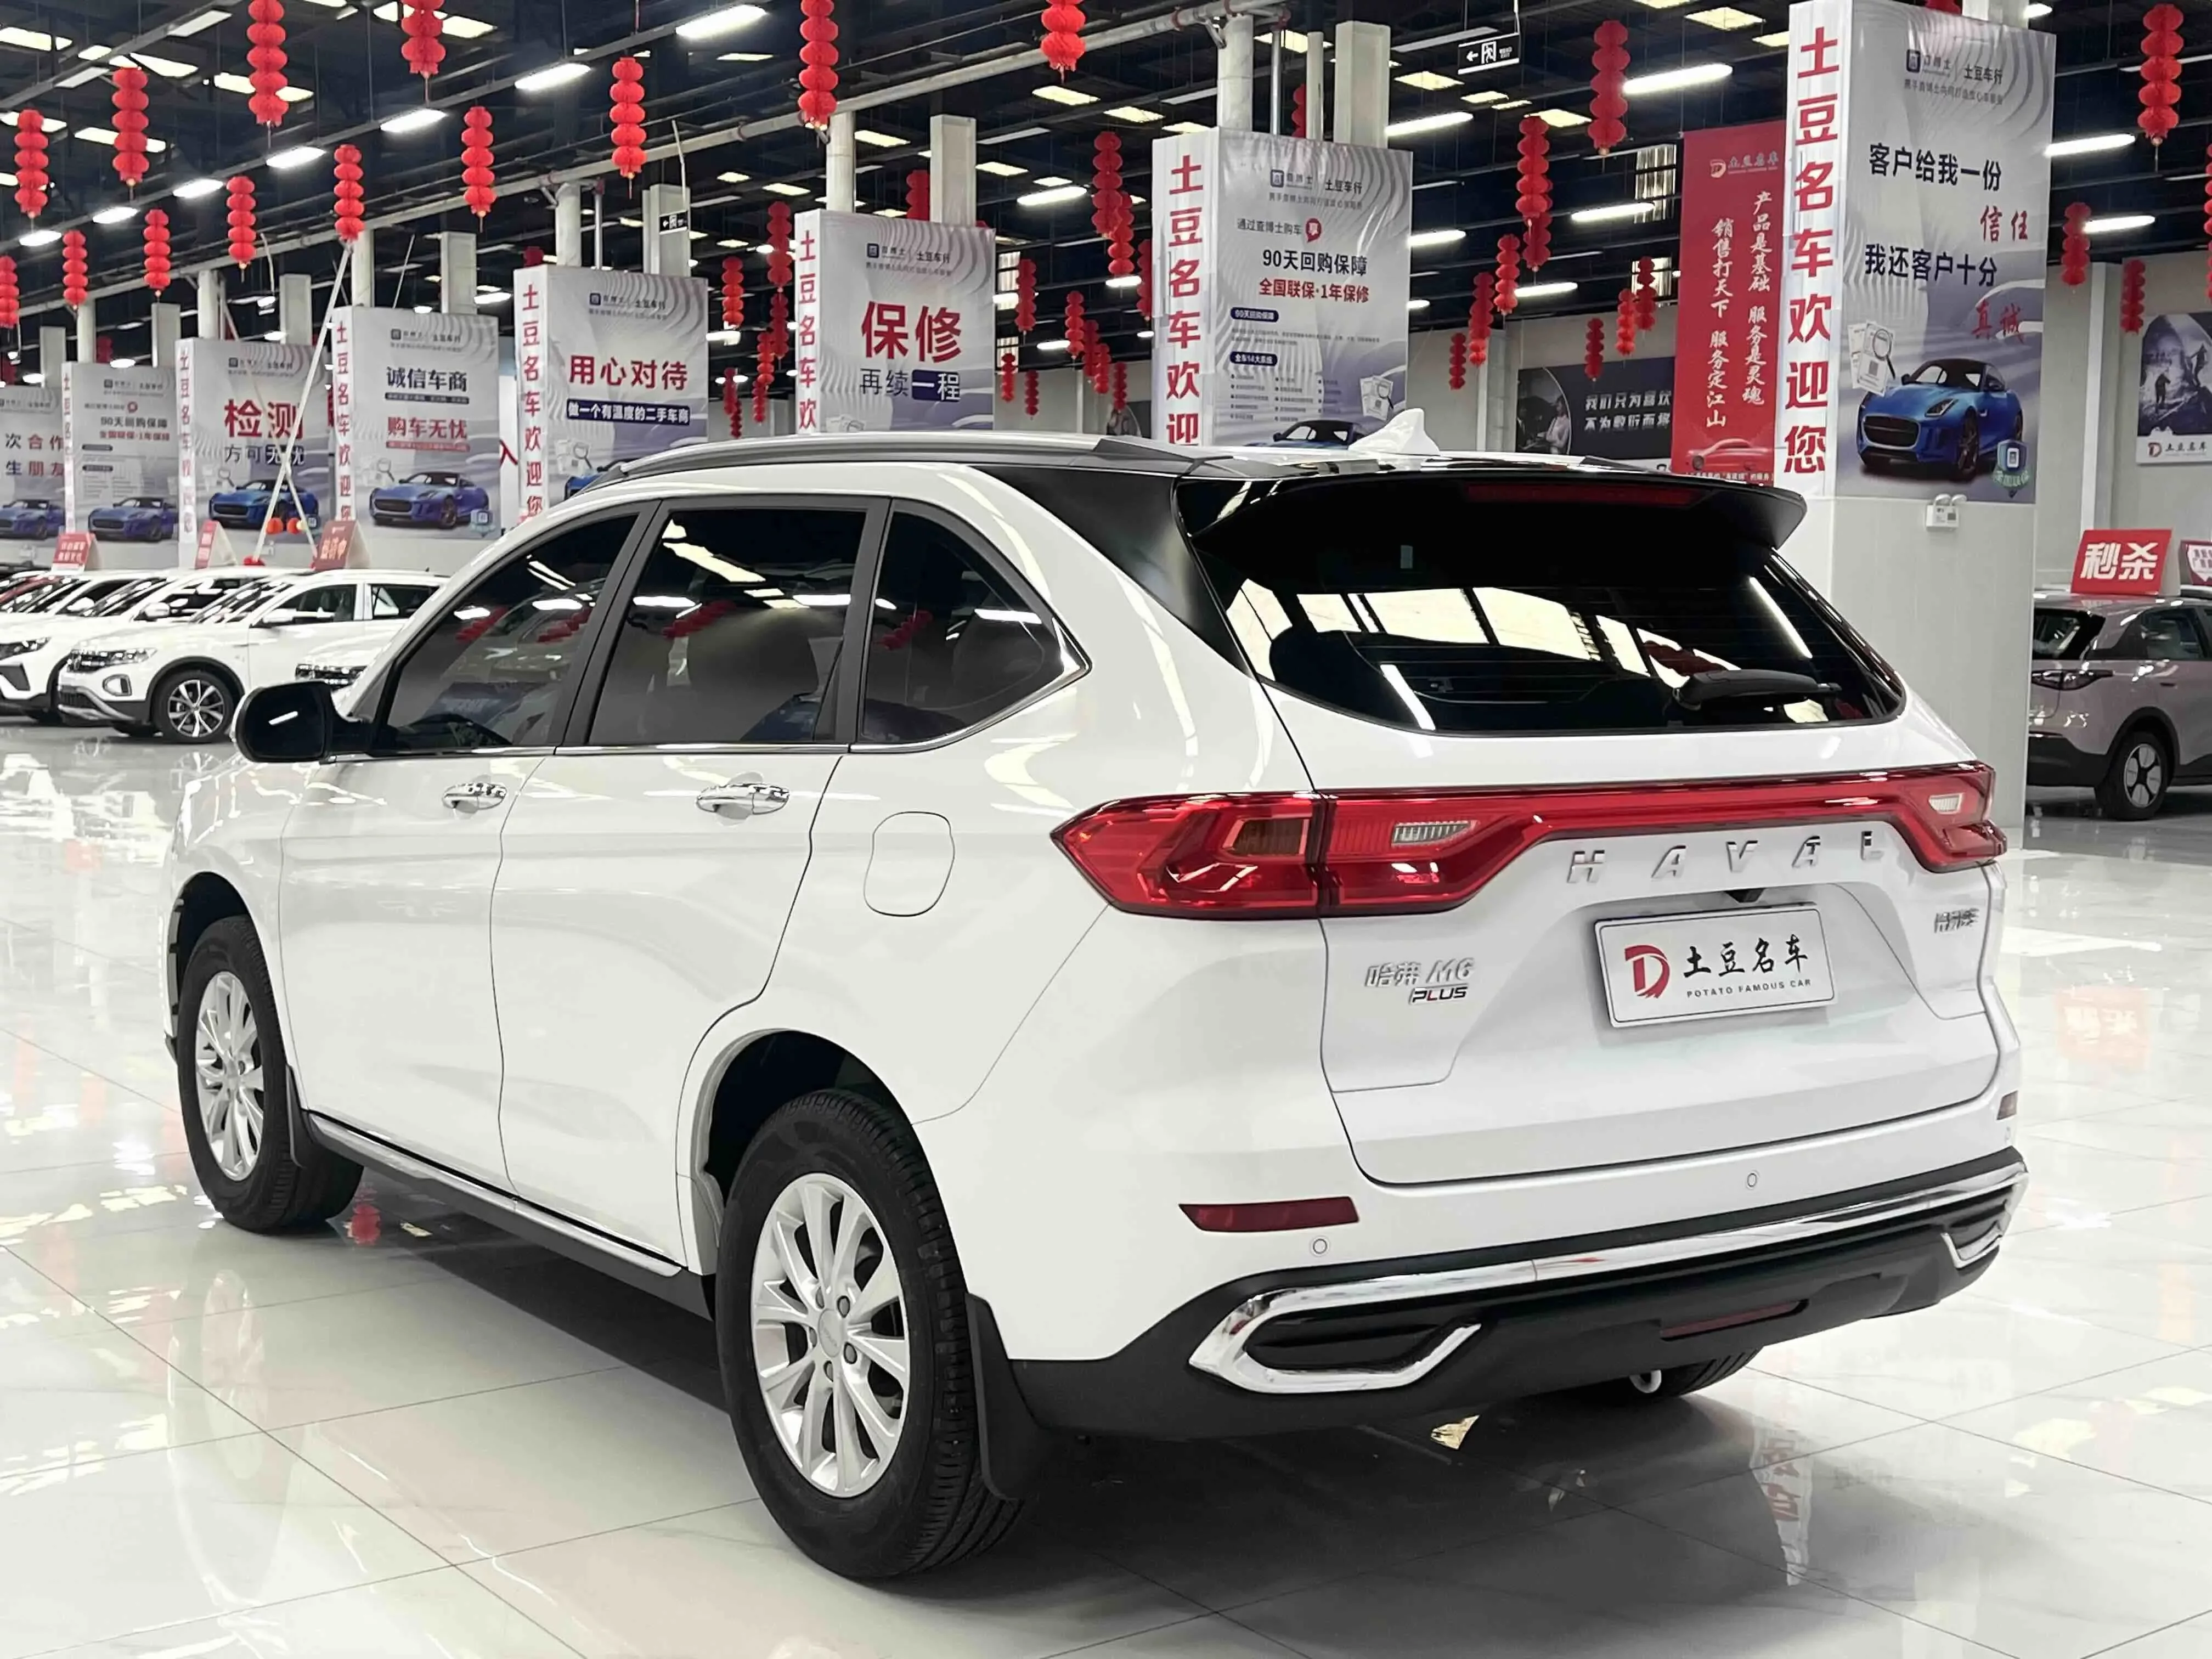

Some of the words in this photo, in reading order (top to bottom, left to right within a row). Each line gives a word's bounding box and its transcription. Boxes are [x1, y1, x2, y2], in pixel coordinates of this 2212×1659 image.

[1964, 65, 2002, 84] 土豆车行
[1869, 143, 2001, 191] 客户给我一份
[1325, 179, 1362, 194] 土豆车行
[1748, 191, 1773, 292] 产品是基础
[1980, 206, 2028, 242] 信任
[1263, 250, 1368, 276] 90天回购保障
[1784, 26, 1839, 473] 土豆名车欢迎您
[1865, 243, 1997, 286] 我还客户十分
[799, 230, 816, 429] 土豆名车欢
[861, 301, 962, 363] 保修
[1972, 299, 2026, 343] 真诚
[569, 355, 688, 390] 用心对待
[1742, 306, 1768, 405] 服务是灵魂
[386, 366, 467, 392] 诚信车商
[860, 368, 961, 401] 再续一程
[1705, 330, 1729, 428] 服务定江山
[224, 399, 303, 439] 检测
[387, 417, 468, 439] 购车无忧
[568, 402, 690, 424] 做一个有温度的二手车商
[225, 444, 304, 466] 方可无忧
[2081, 541, 2158, 580] 秒杀
[1567, 831, 1884, 883] HAVAL
[1364, 962, 1421, 987] 哈弗
[1427, 957, 1474, 984] M6
[1684, 934, 1808, 978] 土豆名车
[1409, 987, 1469, 1005] PLUS
[1687, 987, 1733, 998] POTATO
[1739, 982, 1785, 992] FAMOUS
[1790, 979, 1811, 988] CAR
